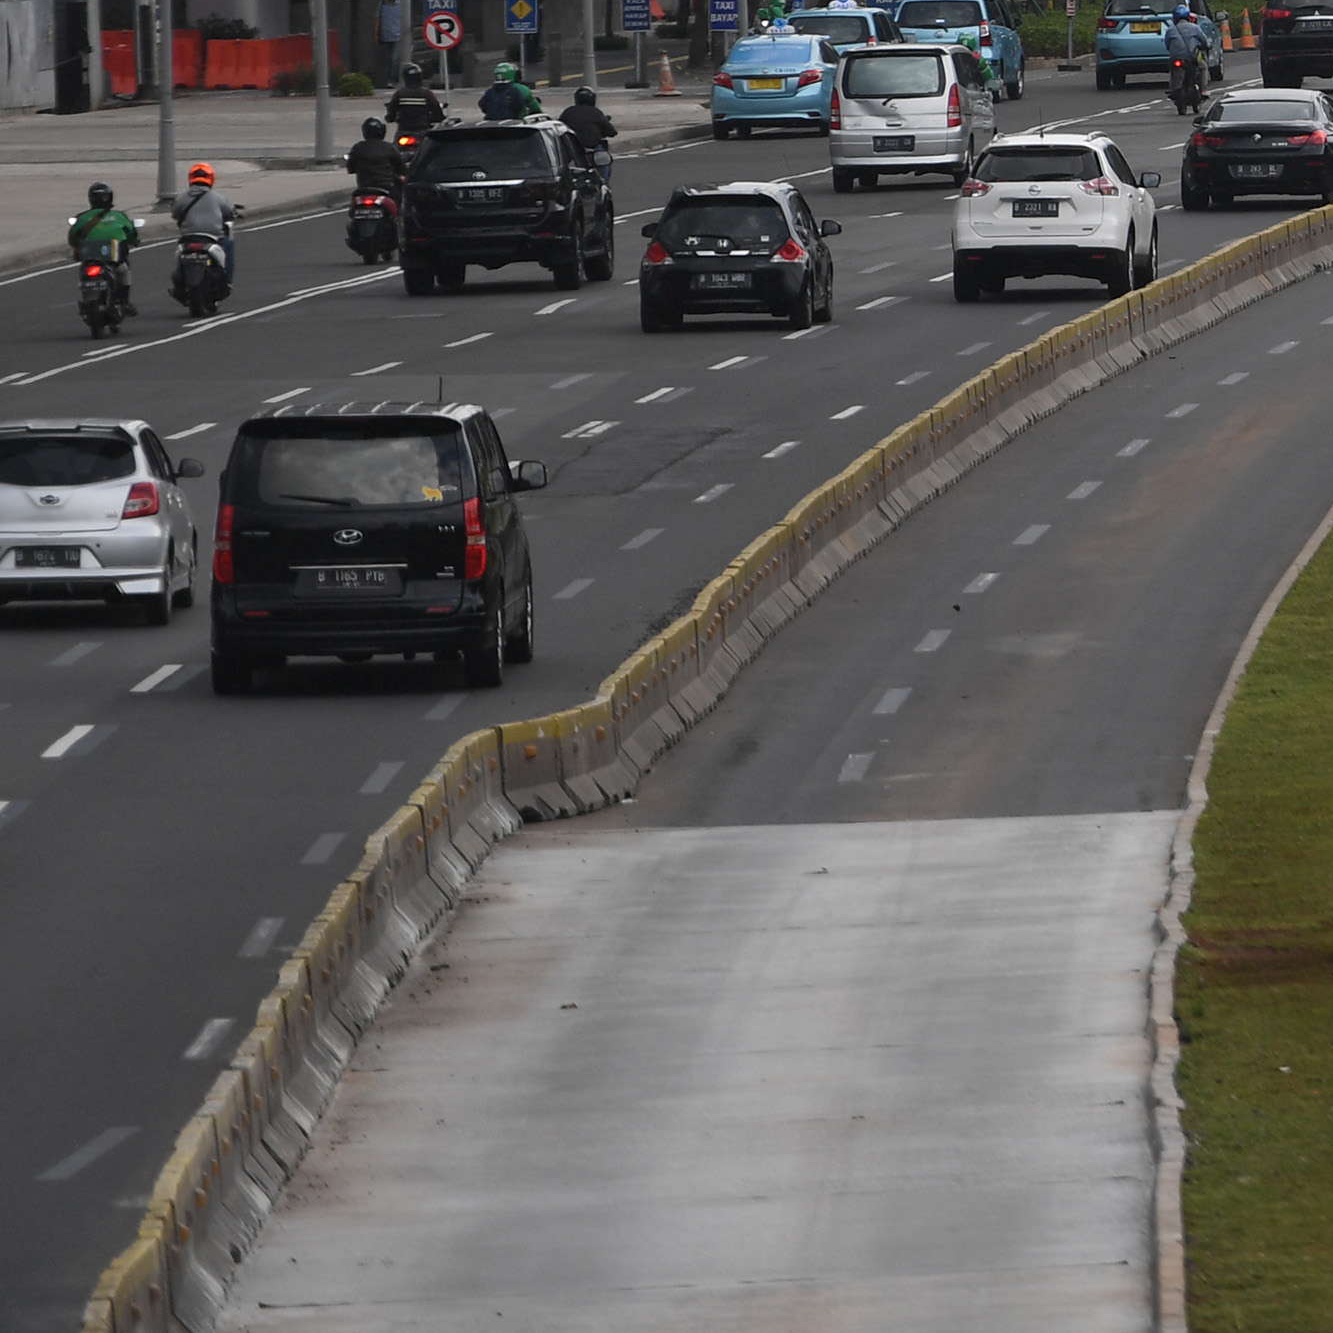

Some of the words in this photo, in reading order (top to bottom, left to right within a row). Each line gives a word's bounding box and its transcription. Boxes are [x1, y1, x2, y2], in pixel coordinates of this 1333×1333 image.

[427, 0, 455, 9] TAXI
[714, 1, 735, 10] TAXI
[318, 570, 325, 582] B
